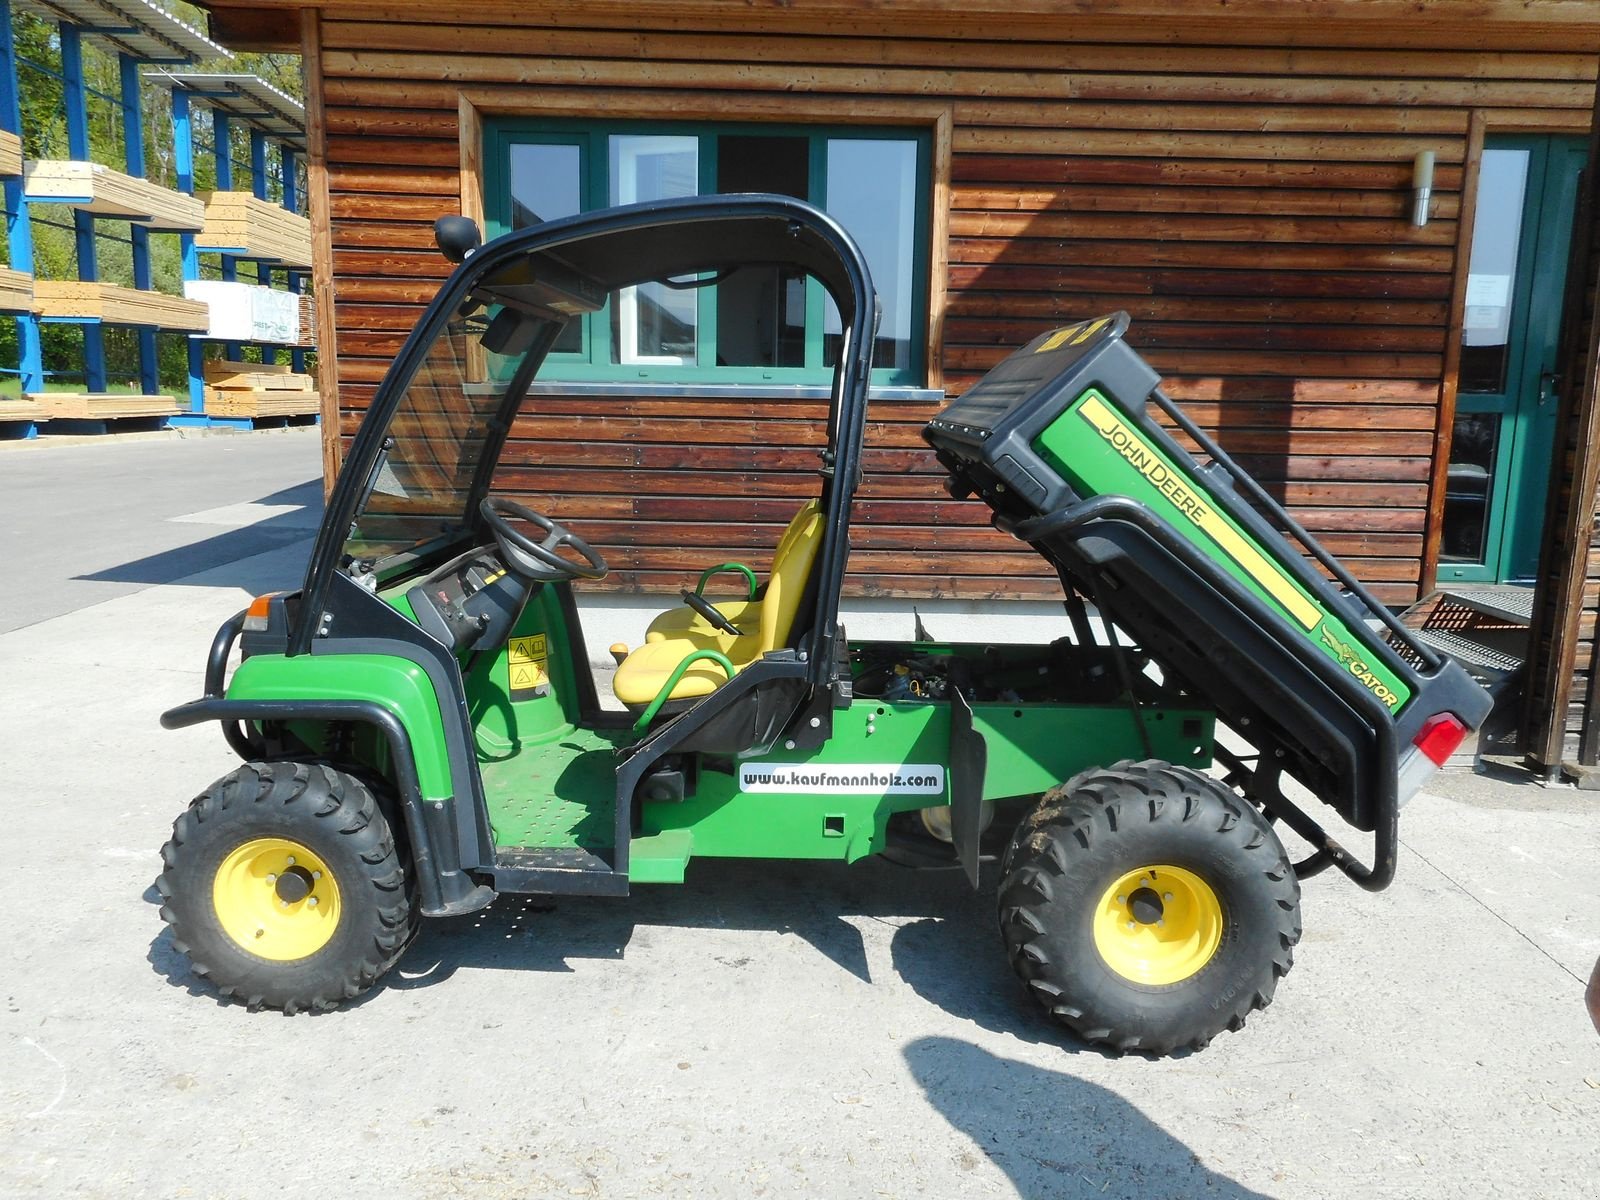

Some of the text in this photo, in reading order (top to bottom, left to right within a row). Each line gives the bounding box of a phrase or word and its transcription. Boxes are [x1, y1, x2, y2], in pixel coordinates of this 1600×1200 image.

[1100, 423, 1207, 523] JOHN DEERE
[1349, 660, 1398, 708] GATOR
[743, 771, 938, 787] www.kaufmannholz.com
